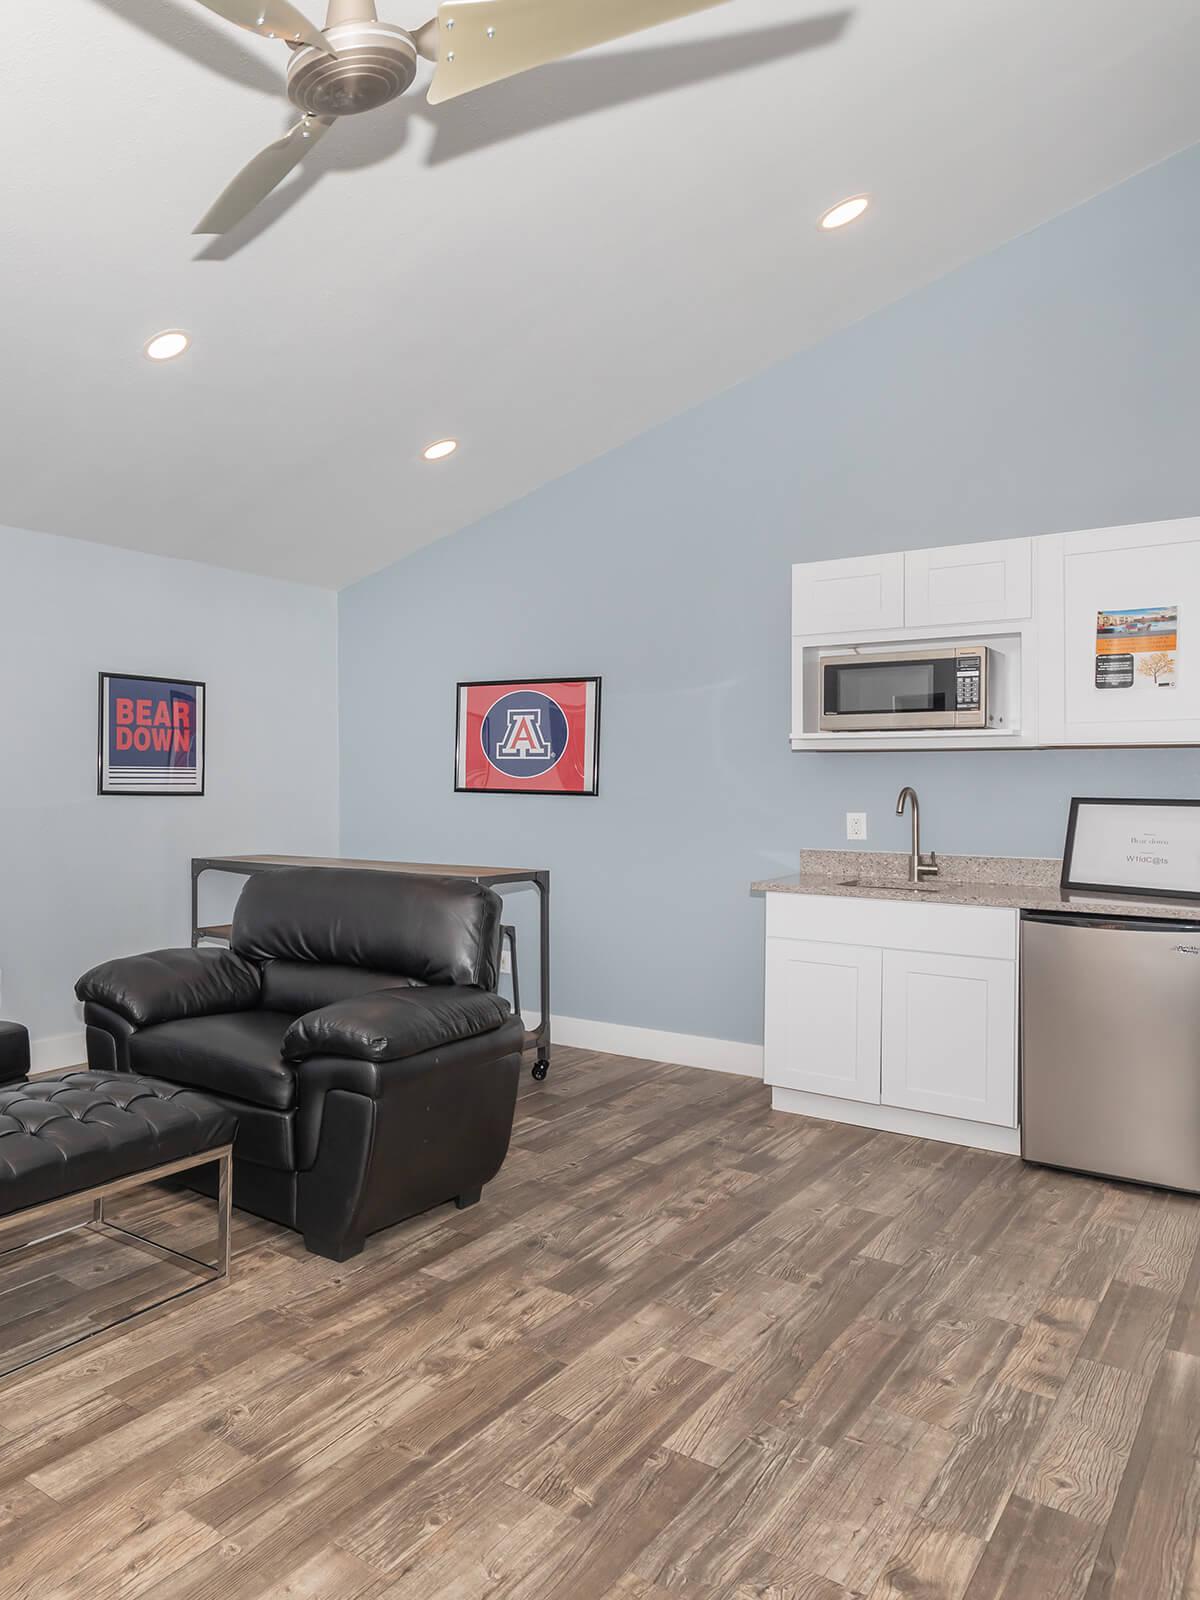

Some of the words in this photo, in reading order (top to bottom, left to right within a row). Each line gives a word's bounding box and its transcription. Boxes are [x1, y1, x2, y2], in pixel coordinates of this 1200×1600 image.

[115, 697, 190, 727] BEAR
[115, 726, 190, 752] DOWN
[496, 708, 550, 759] A
